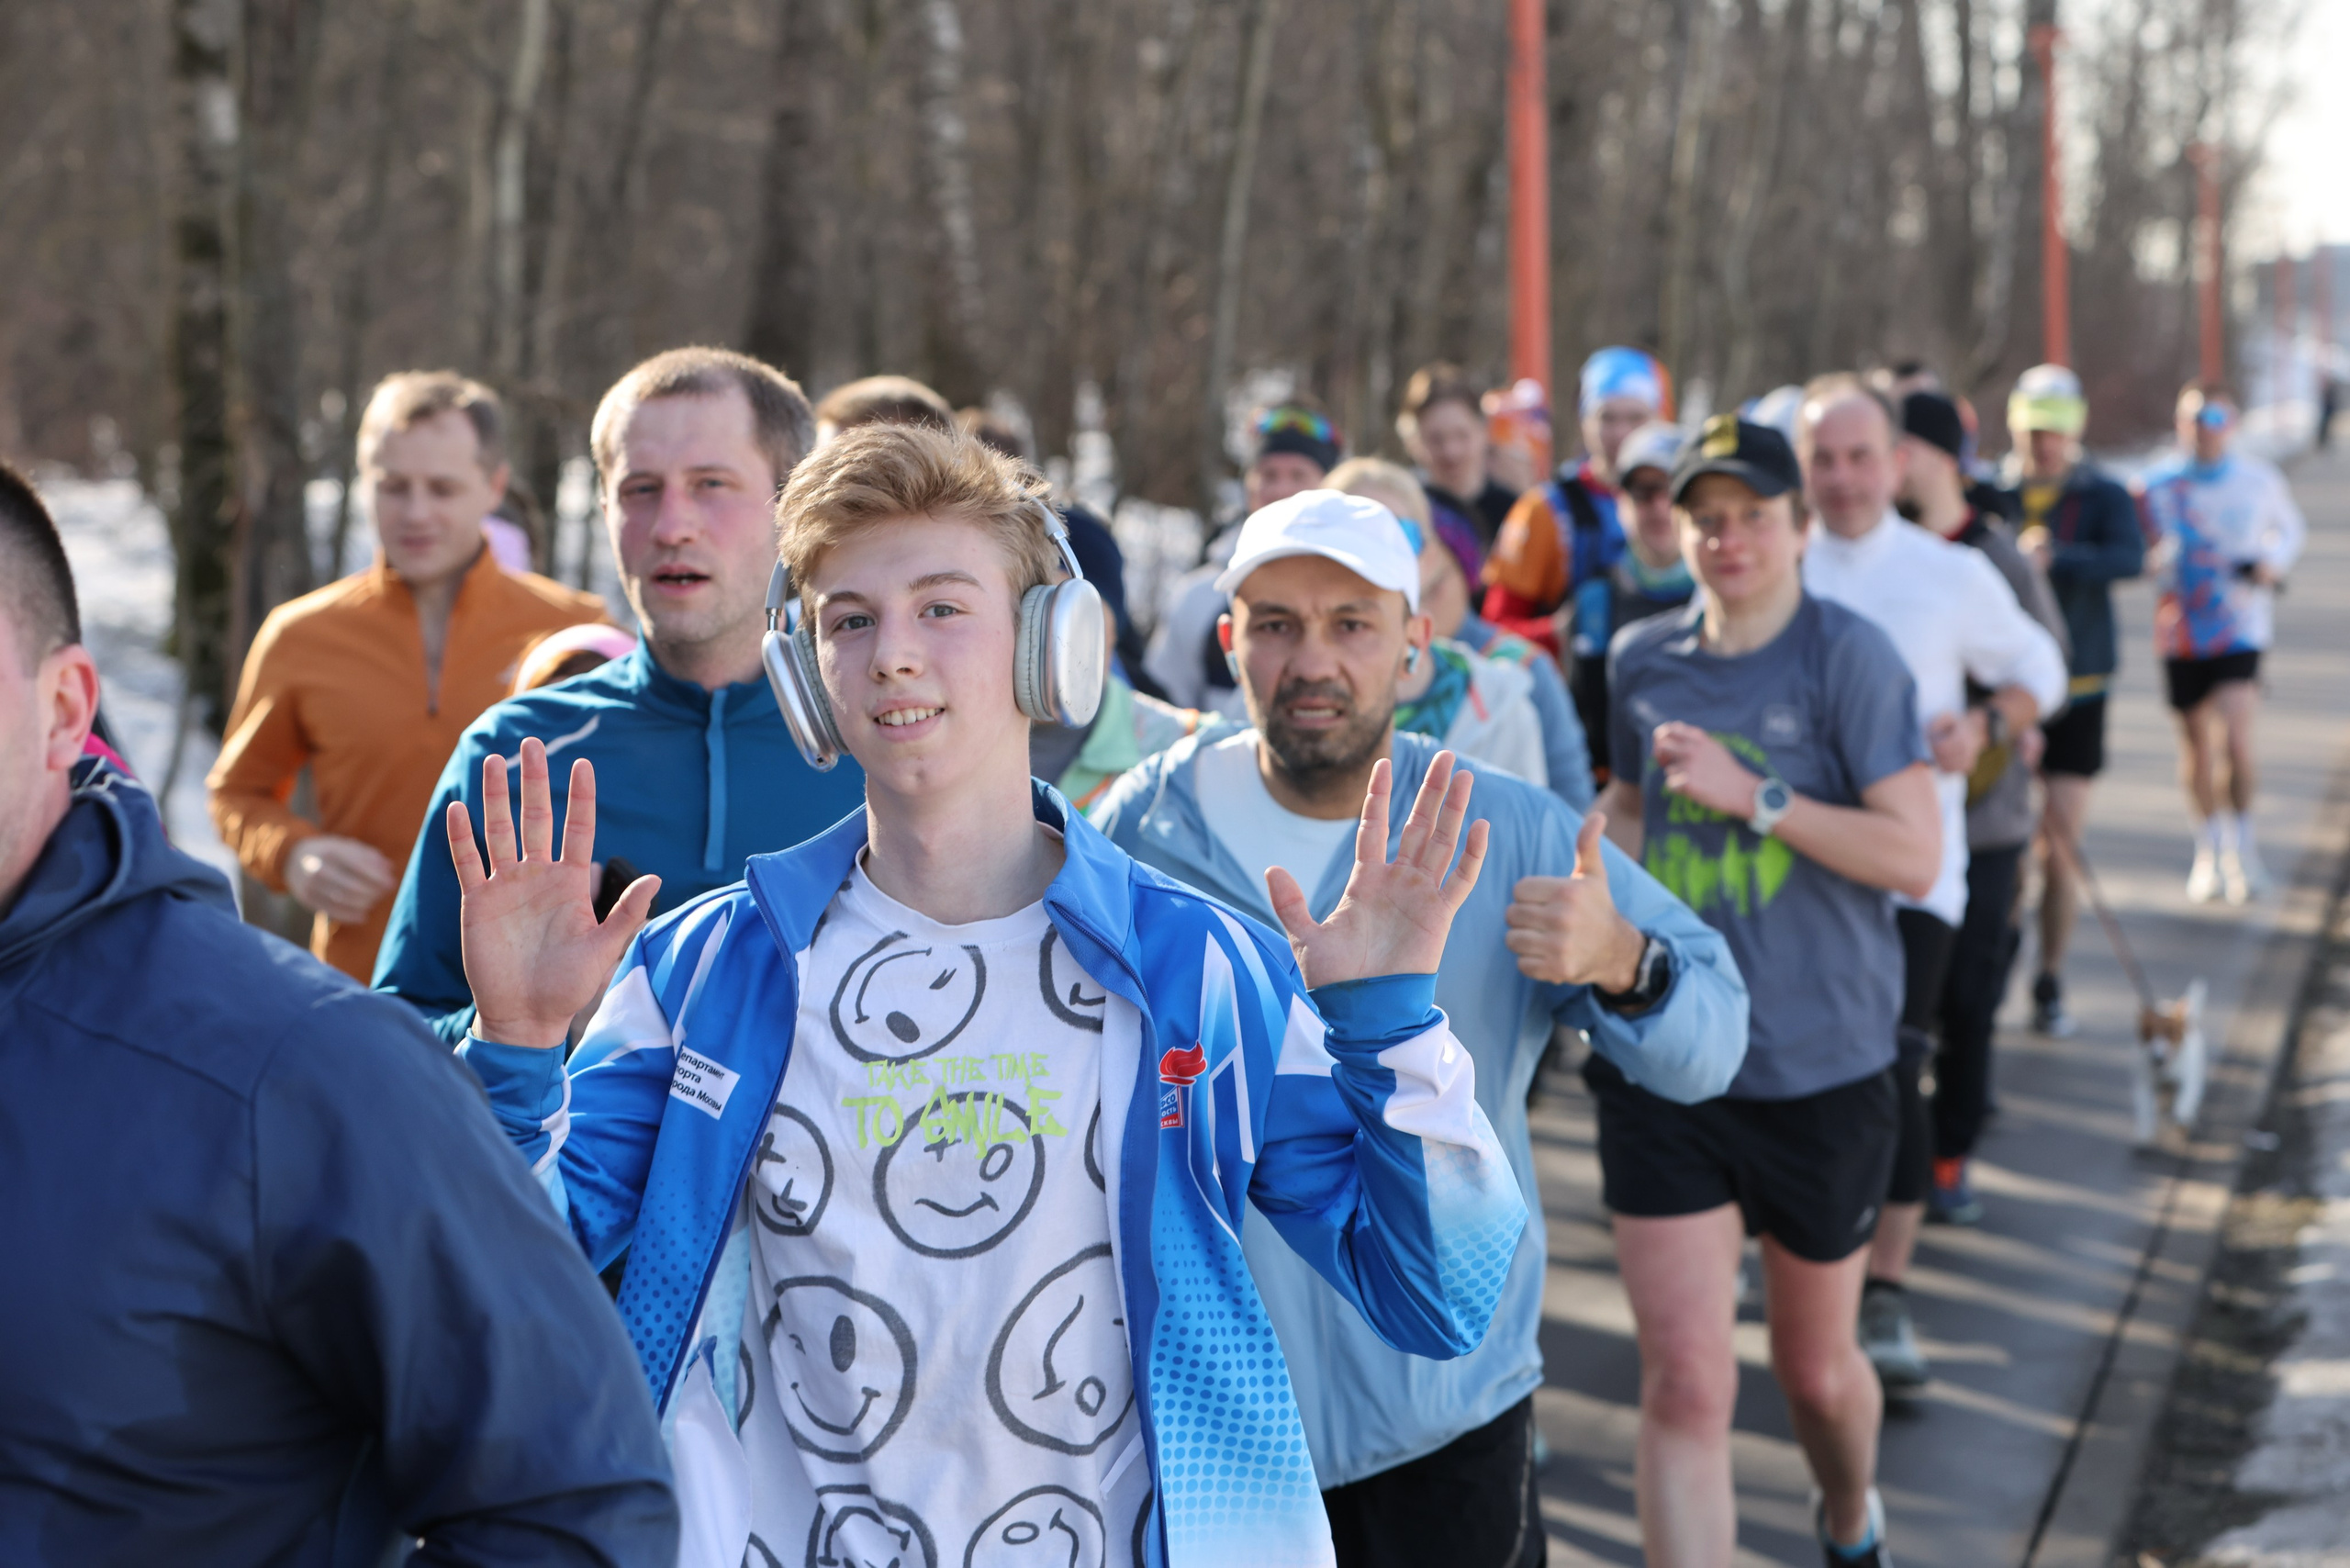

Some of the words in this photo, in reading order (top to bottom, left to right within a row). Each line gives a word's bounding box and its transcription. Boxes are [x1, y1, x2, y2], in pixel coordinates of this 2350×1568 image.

[862, 1058, 930, 1091] TAKE
[933, 1057, 987, 1084] THE
[990, 1052, 1050, 1087] TIME
[841, 1094, 904, 1149] TO
[919, 1084, 1069, 1159] SMILE
